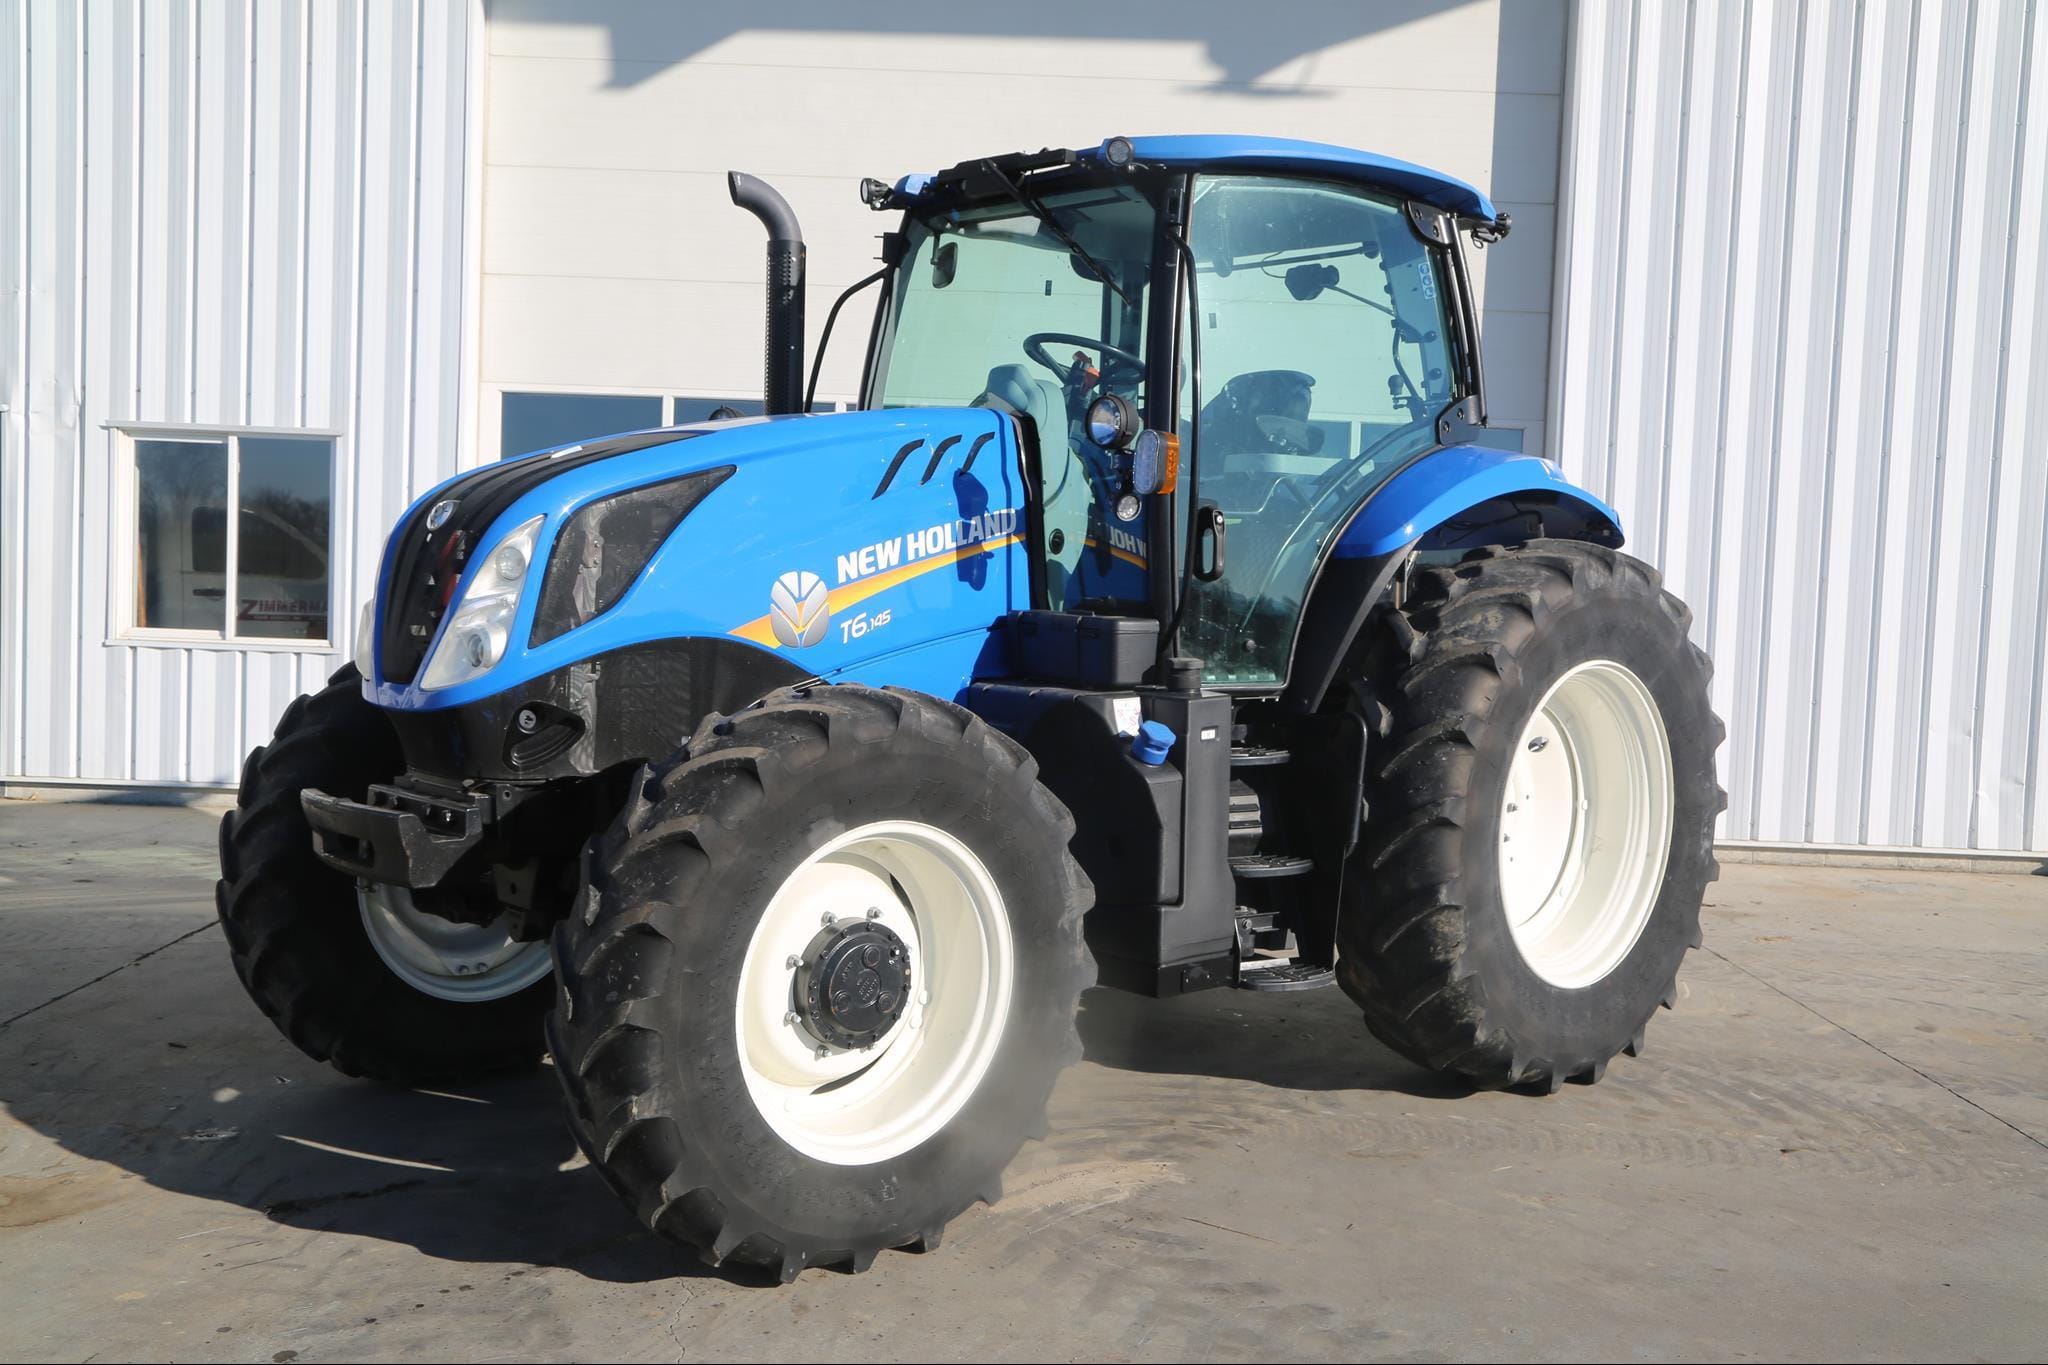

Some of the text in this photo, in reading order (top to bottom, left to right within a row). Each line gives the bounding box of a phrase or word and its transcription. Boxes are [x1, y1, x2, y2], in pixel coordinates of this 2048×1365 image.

[837, 508, 1016, 583] NEW HOLLAND
[840, 609, 892, 644] T6.145
